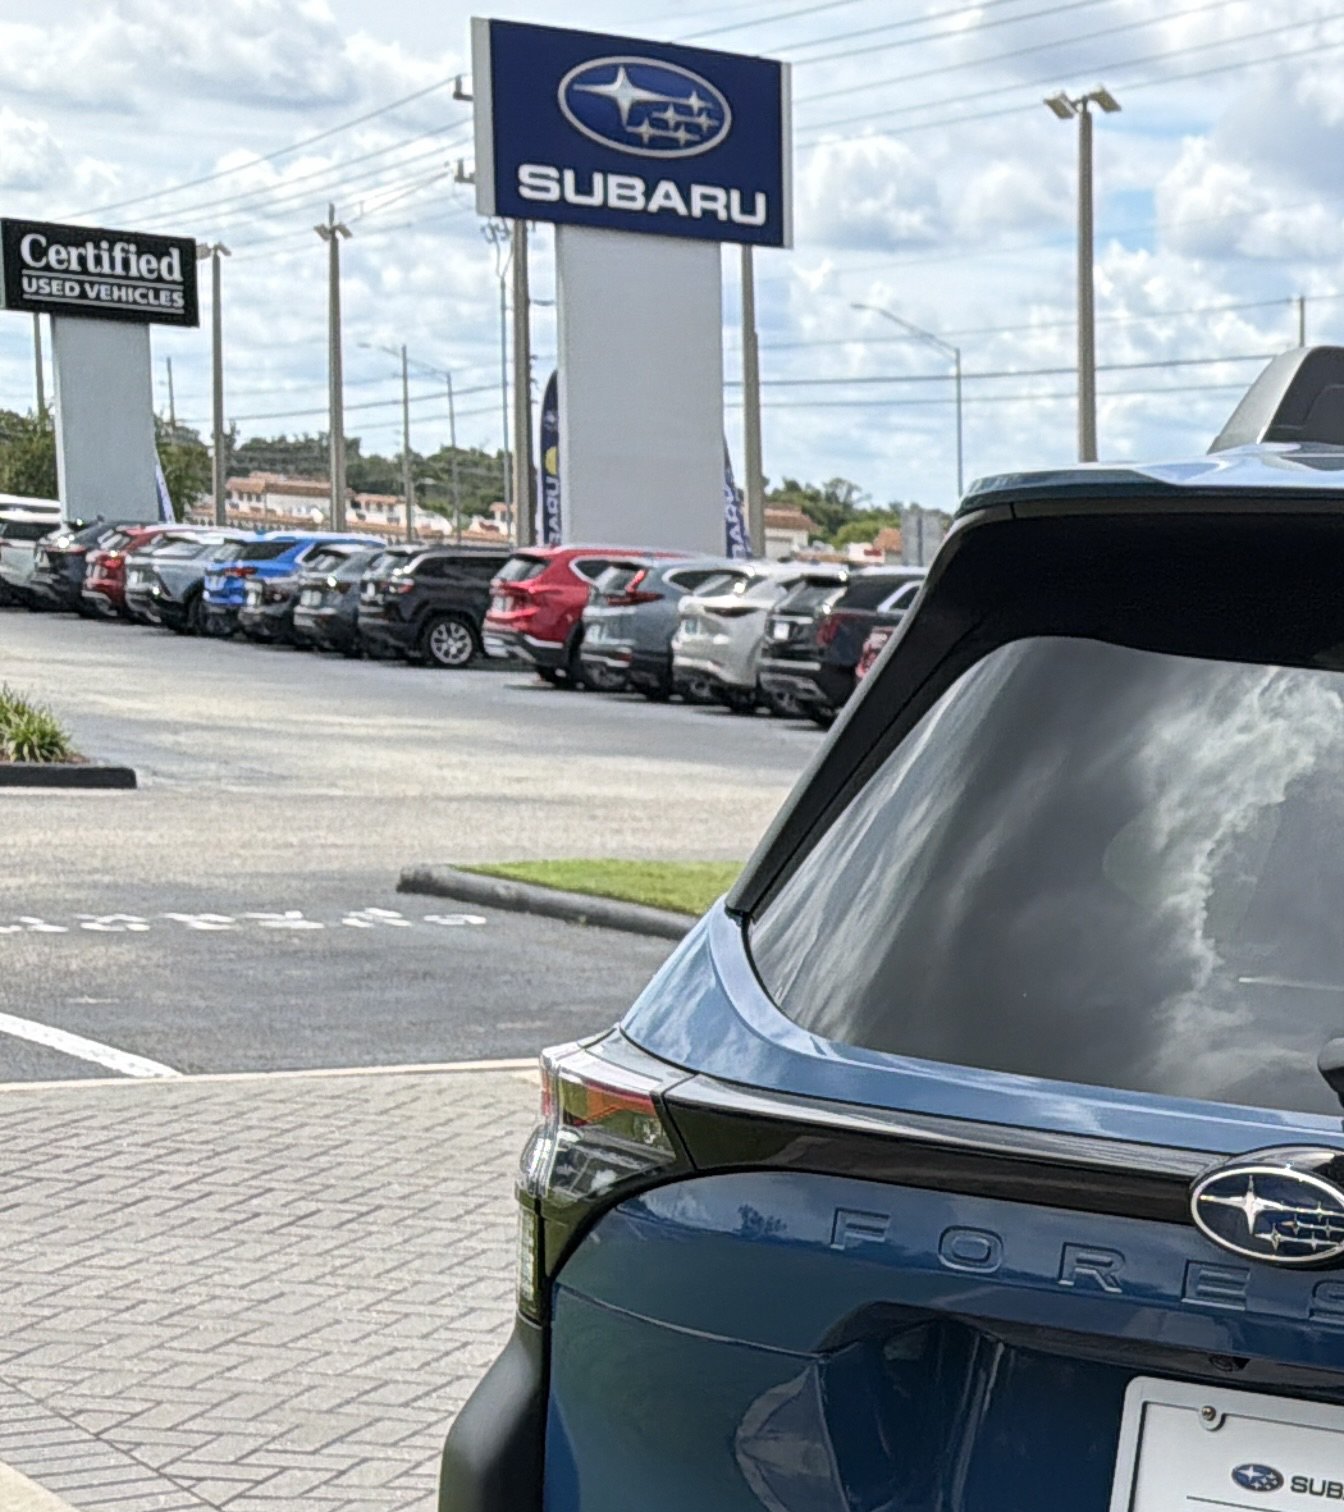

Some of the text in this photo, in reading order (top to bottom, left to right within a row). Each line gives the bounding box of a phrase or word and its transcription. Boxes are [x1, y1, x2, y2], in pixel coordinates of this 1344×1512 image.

[517, 163, 767, 226] SUBARU
[20, 233, 184, 282] Certified
[22, 276, 185, 309] USED VEHICLES
